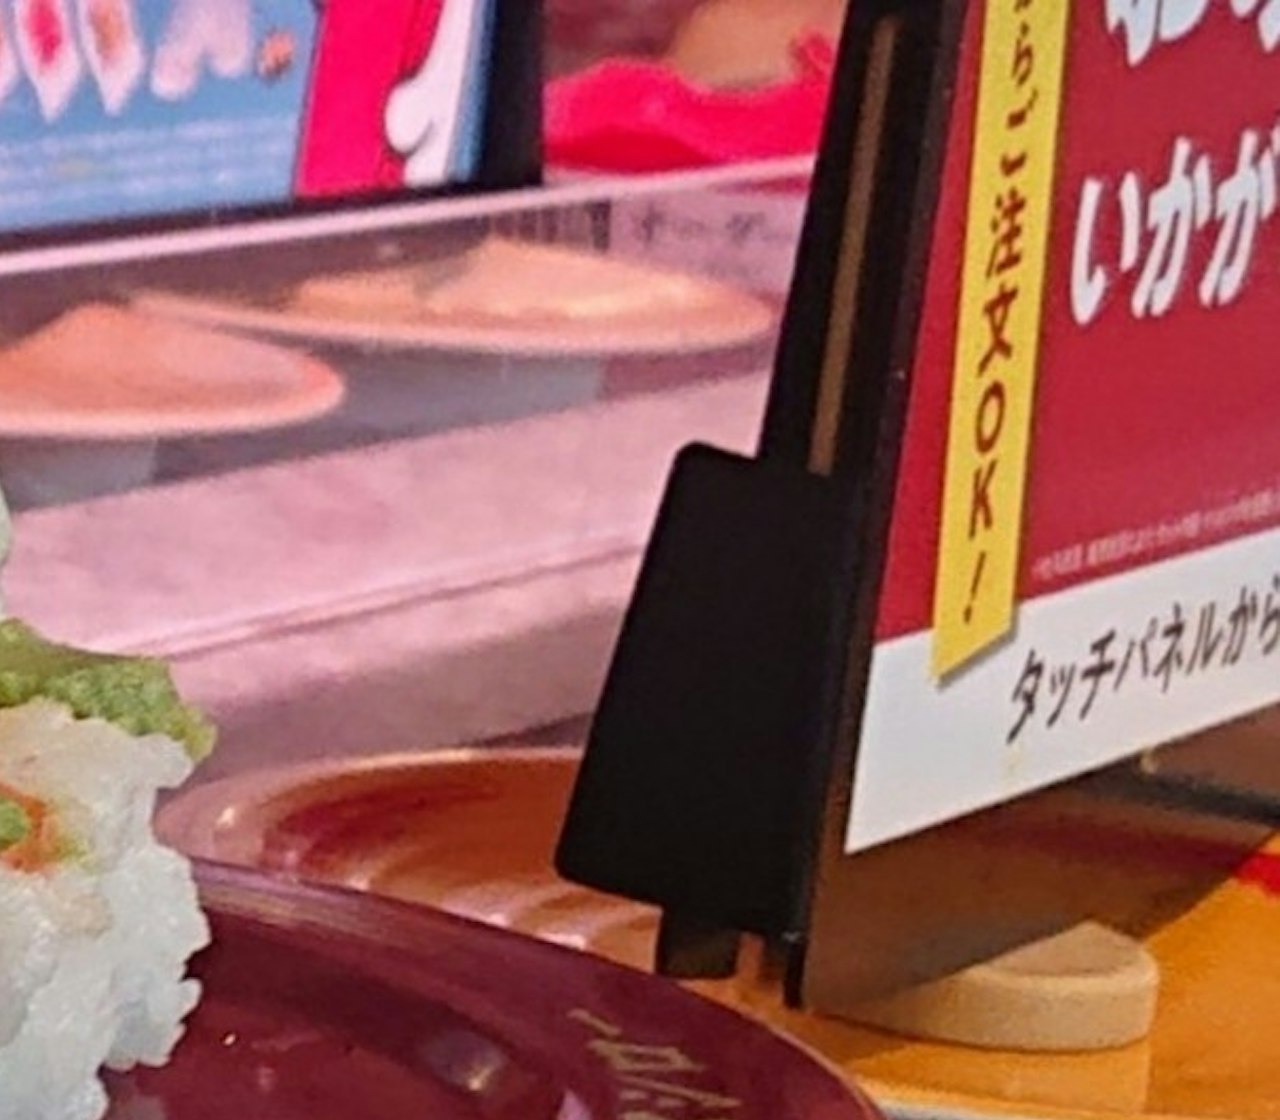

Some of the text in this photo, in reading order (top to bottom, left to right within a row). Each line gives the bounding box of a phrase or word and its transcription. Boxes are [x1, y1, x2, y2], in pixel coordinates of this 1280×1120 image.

[1070, 122, 1280, 326] いかが
[1006, 574, 1280, 744] タッチパネルから
